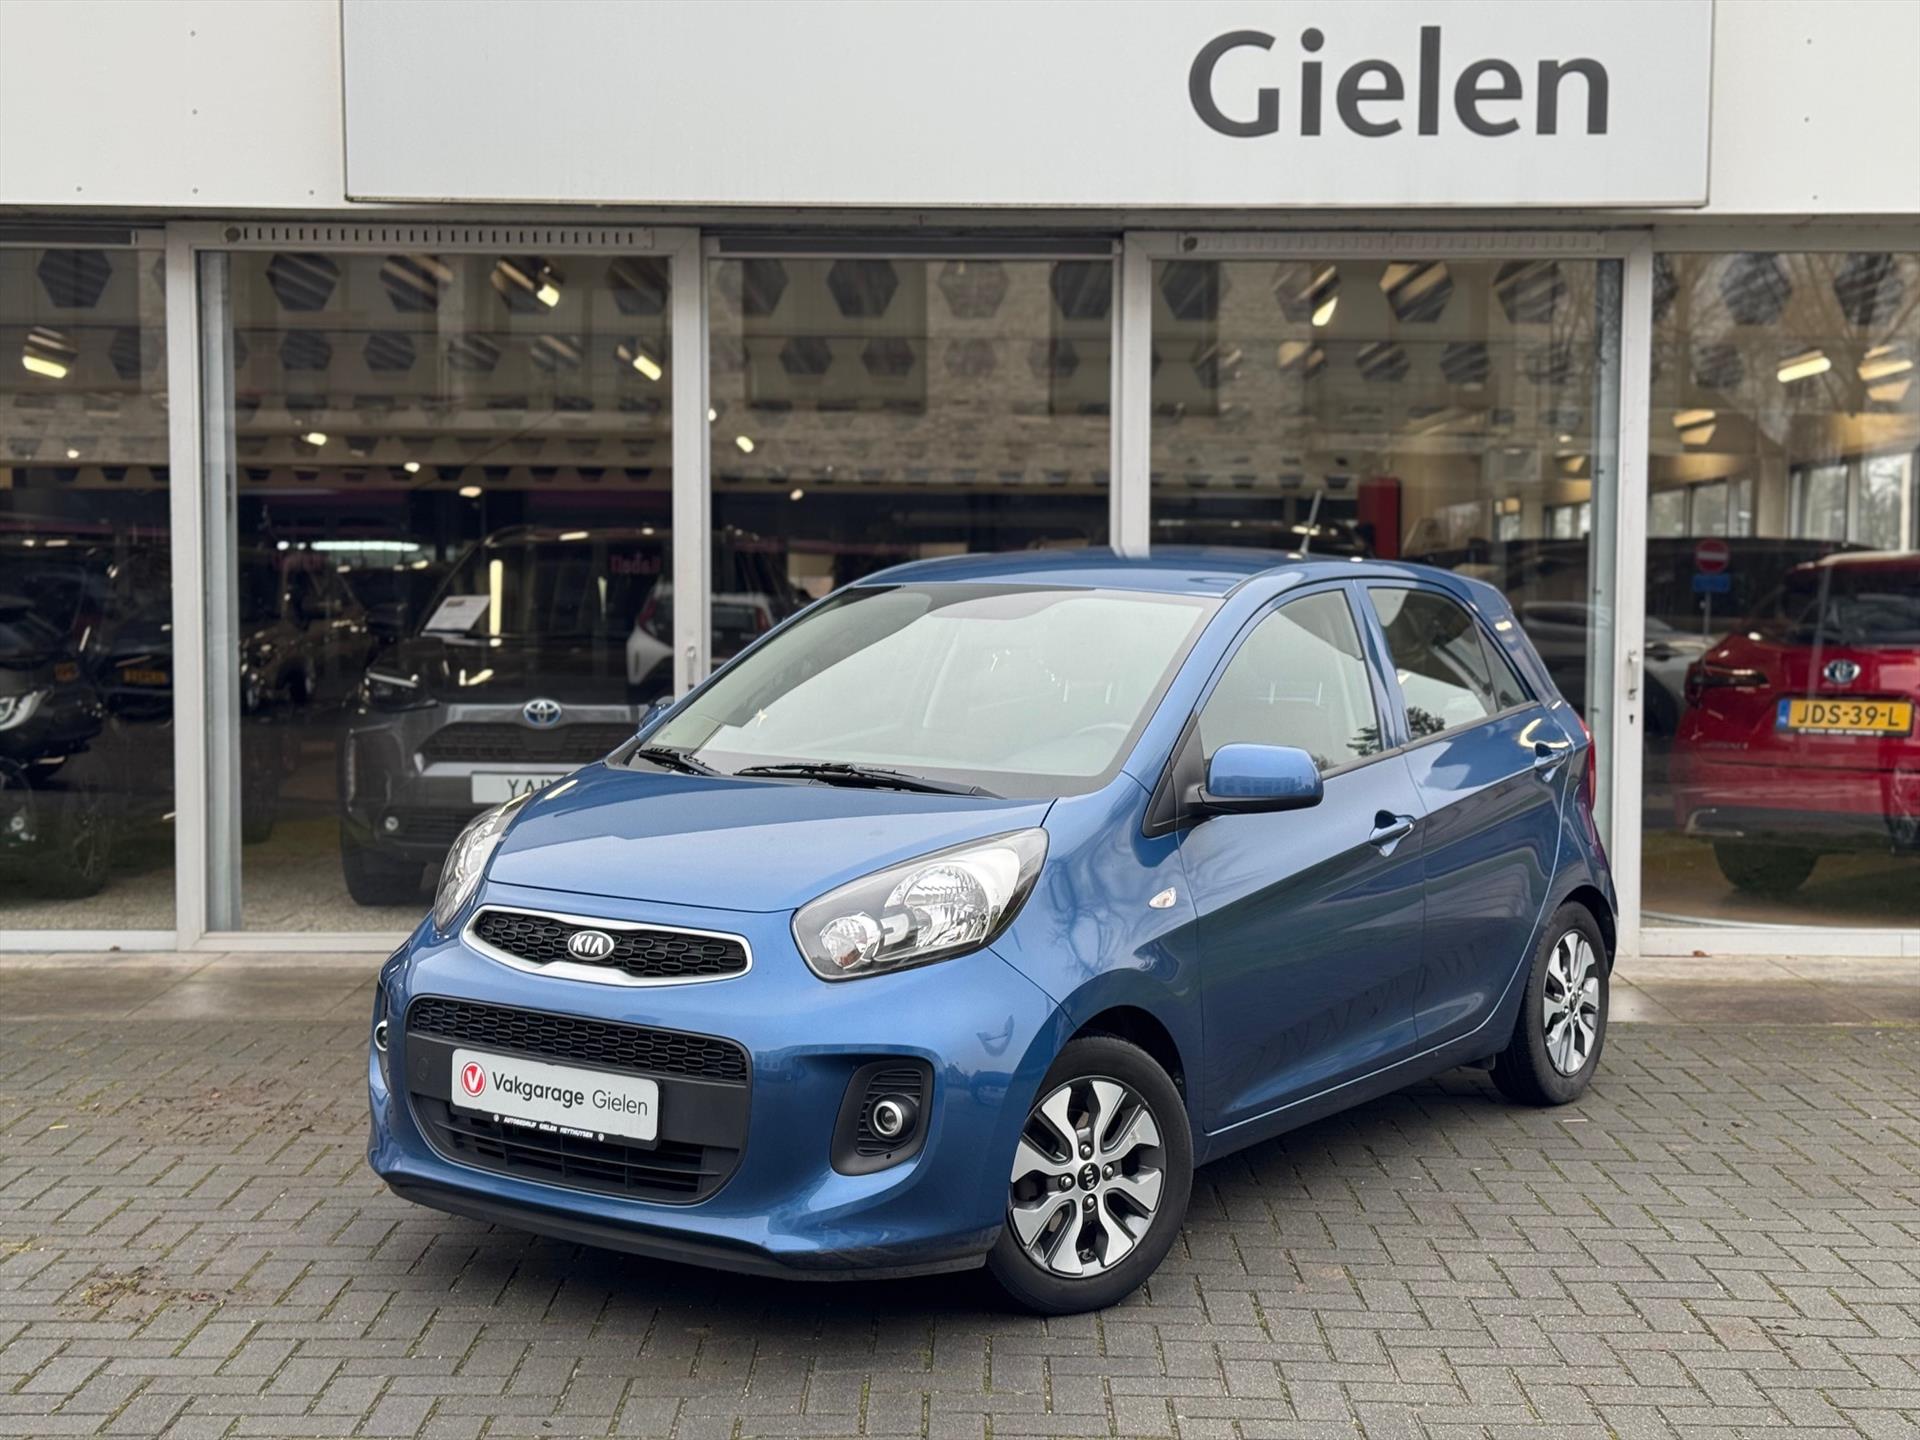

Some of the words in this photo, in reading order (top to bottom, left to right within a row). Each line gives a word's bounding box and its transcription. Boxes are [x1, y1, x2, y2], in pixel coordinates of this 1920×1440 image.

[1188, 26, 1609, 138] Gielen
[1797, 703, 1900, 728] JDS-39-L
[572, 934, 604, 955] KIA
[492, 1071, 585, 1109] Vakgarage
[592, 1089, 649, 1116] Gielen
[539, 1123, 558, 1132] GIELEN
[1084, 1164, 1096, 1190] KIA
